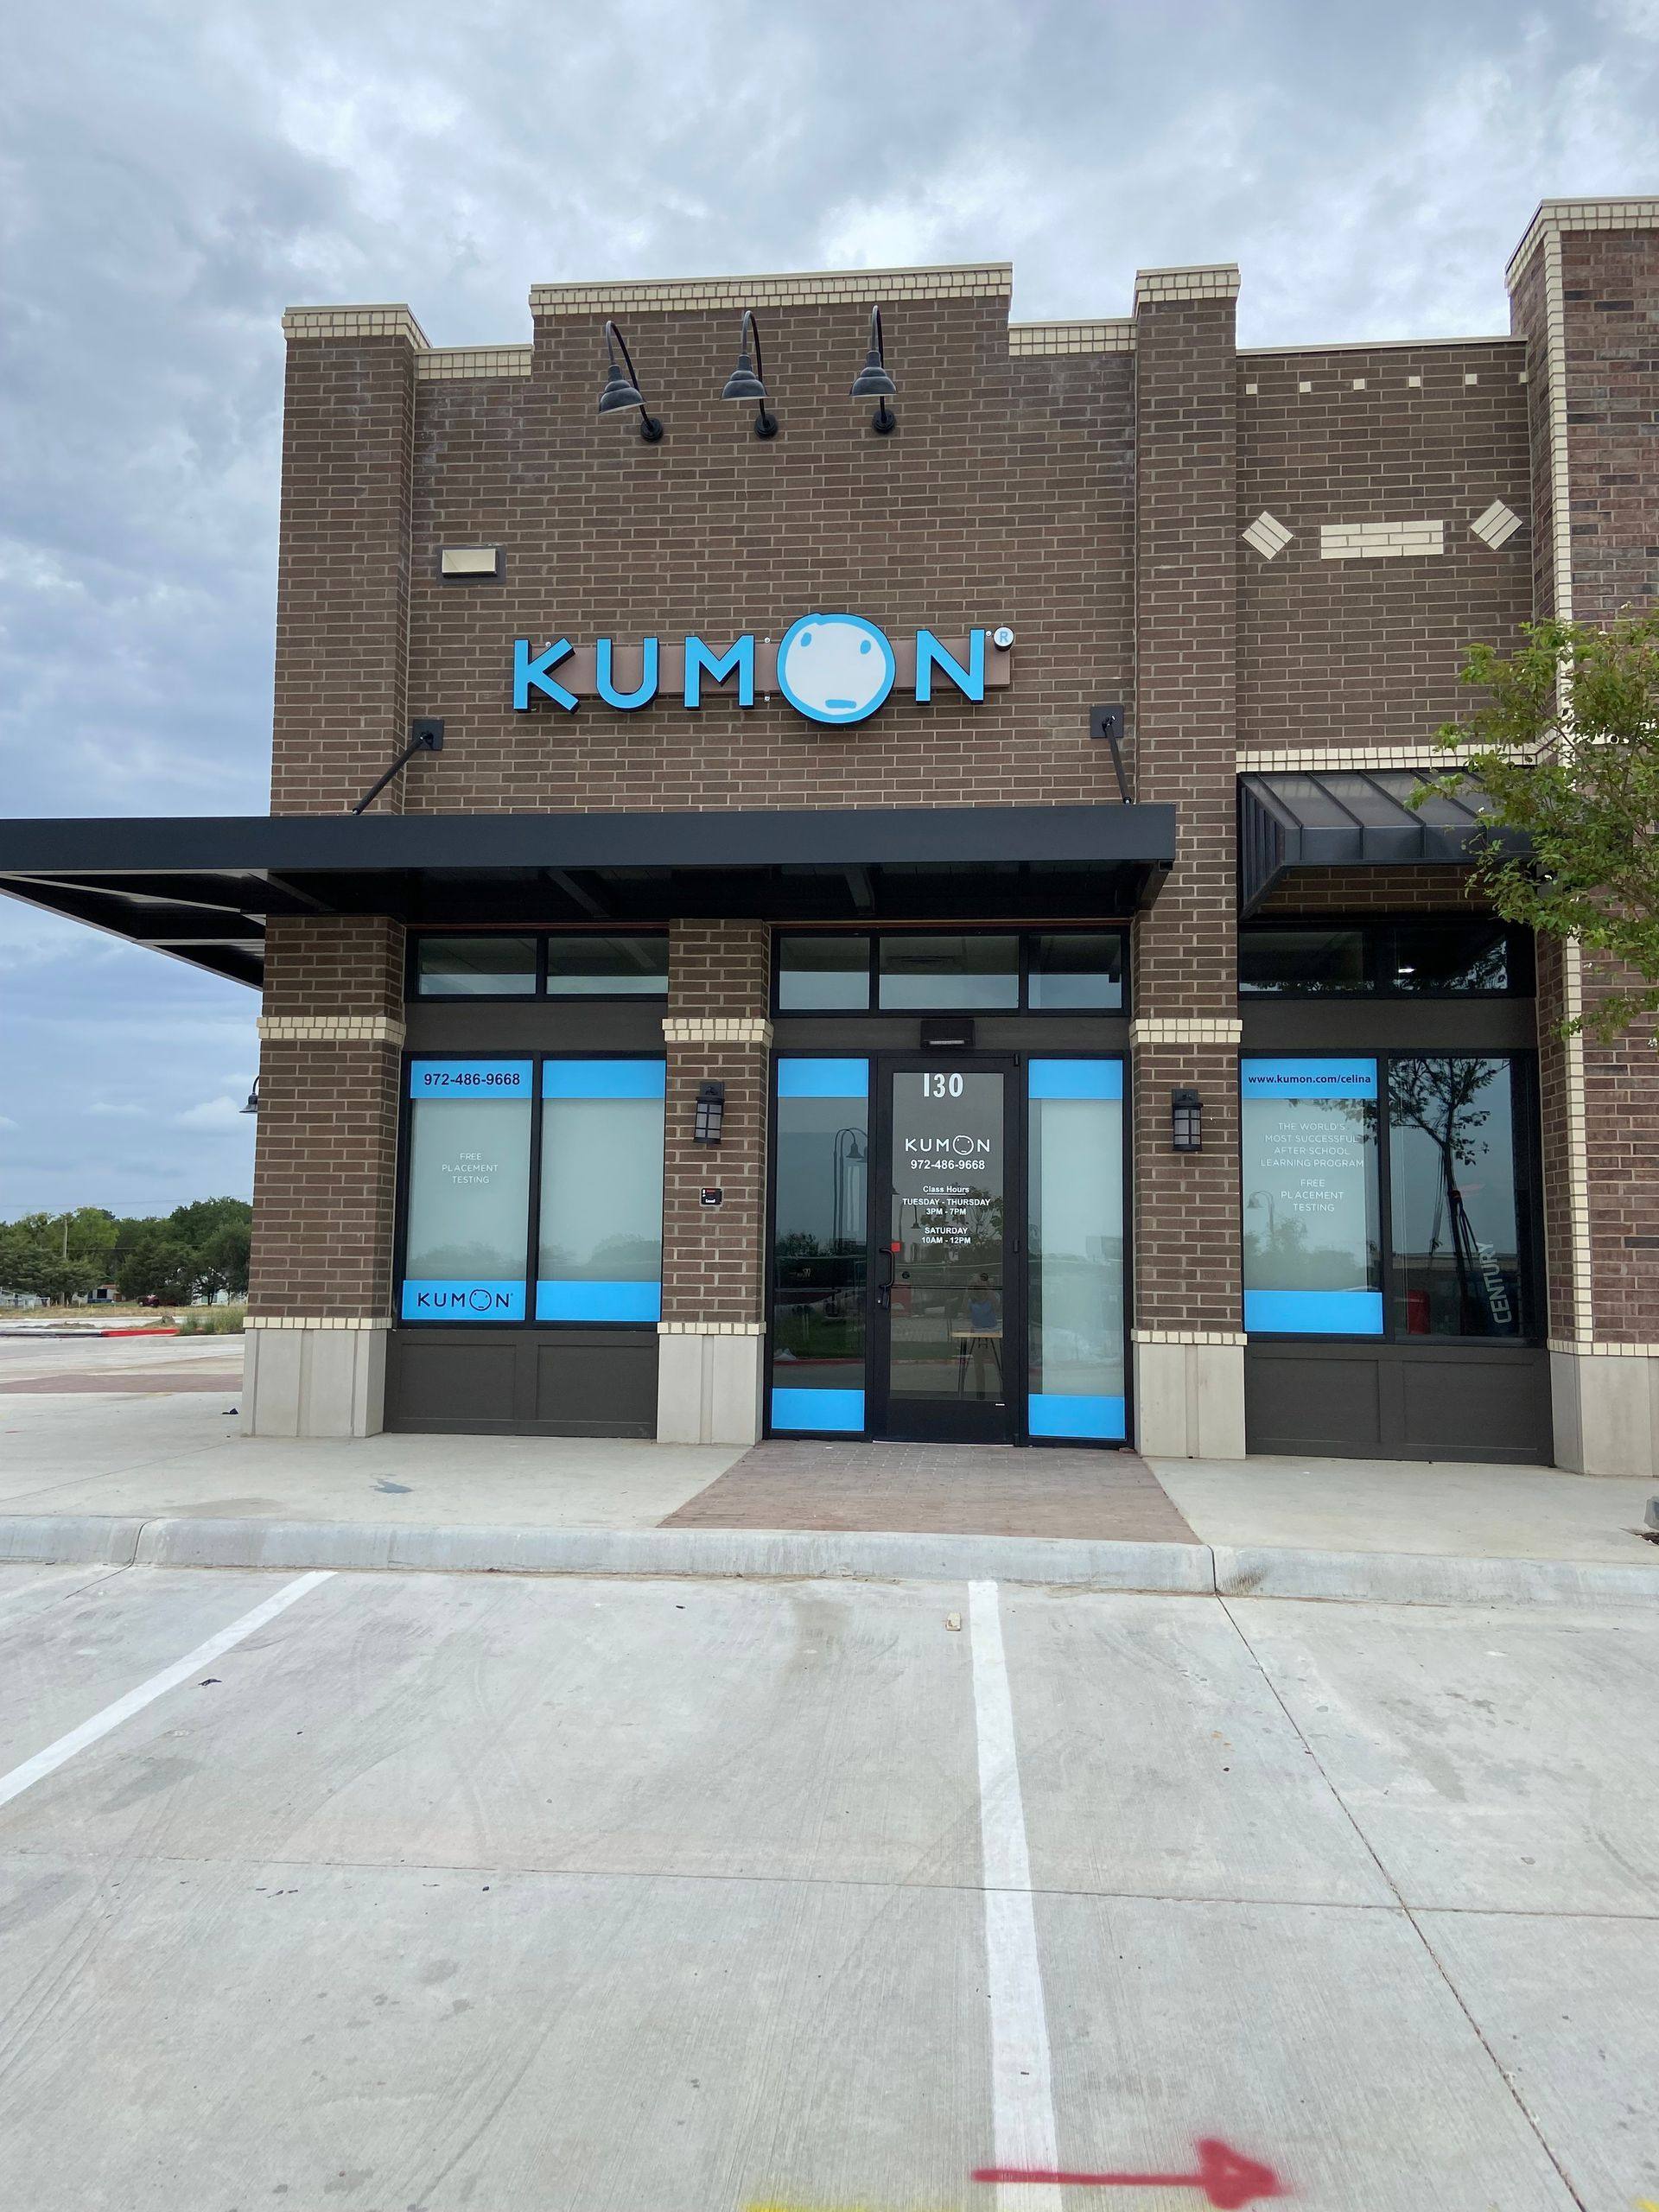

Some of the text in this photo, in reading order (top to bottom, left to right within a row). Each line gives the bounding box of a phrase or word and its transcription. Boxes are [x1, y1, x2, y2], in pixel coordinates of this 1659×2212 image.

[513, 613, 986, 727] KUMON
[424, 1073, 520, 1086] 972-486-9668
[1249, 1074, 1371, 1084] www.kumon.com/celina
[923, 1073, 963, 1097] 130
[1300, 1122, 1346, 1131] WORLD'S
[1265, 1135, 1359, 1143] MOST SUCCESSFUL
[905, 1135, 990, 1155] KUMON
[1274, 1147, 1350, 1155] AFTER SCHOOL
[460, 1152, 482, 1160] FREE
[910, 1159, 985, 1170] 972-486-9668
[1261, 1159, 1364, 1167] LEARNING PROGRAM
[442, 1164, 499, 1173] PLACEMENT
[452, 1175, 490, 1184] TESTING
[1300, 1179, 1325, 1187] FREE
[1281, 1191, 1344, 1199] PLACEMENT
[1294, 1203, 1335, 1211] TESTING
[1476, 1242, 1512, 1324] CENTURY
[417, 1288, 510, 1312] KUMON
